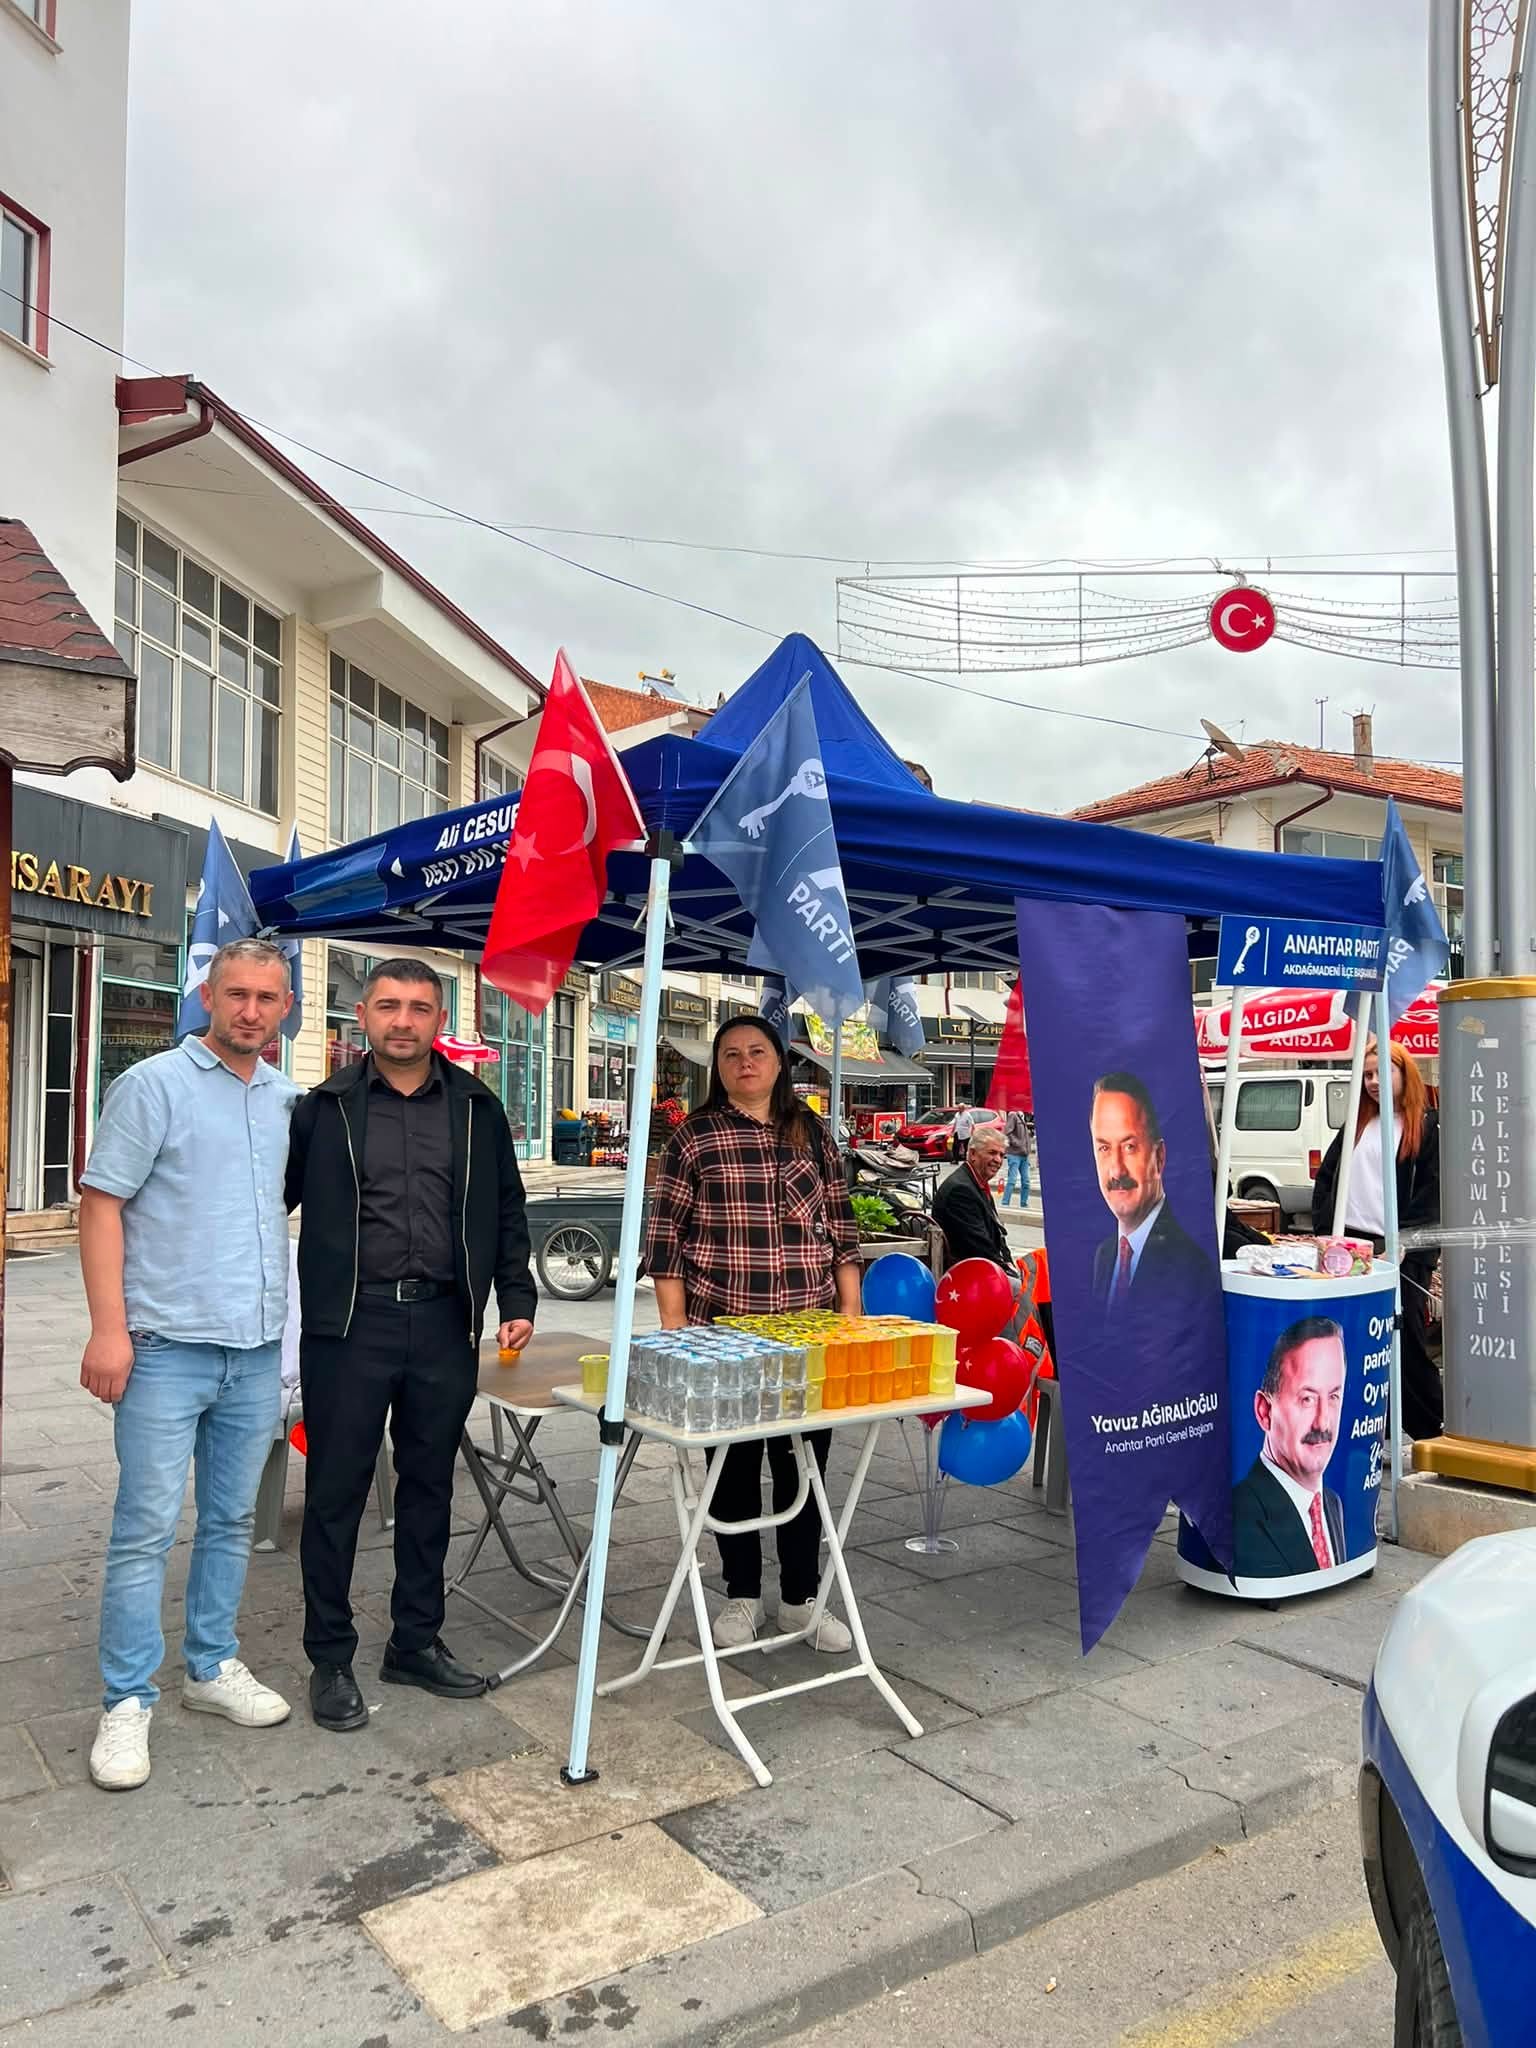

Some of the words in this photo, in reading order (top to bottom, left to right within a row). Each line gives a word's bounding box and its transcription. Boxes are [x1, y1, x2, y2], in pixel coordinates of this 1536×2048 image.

[421, 858, 460, 888] 0537
[460, 847, 496, 875] 810
[1283, 933, 1353, 957] ANAHTAR
[1283, 962, 1341, 977] AKDAĞMADENİ
[1368, 1316, 1385, 1340] Oy
[1469, 1338, 1517, 1361] 2021
[1363, 1382, 1380, 1406] Oy
[1091, 1415, 1139, 1434] Yavuz
[1141, 1392, 1219, 1429] AĞIRALİOĞLU
[1105, 1439, 1144, 1454] Anahtar
[1165, 1426, 1188, 1443] Genel
